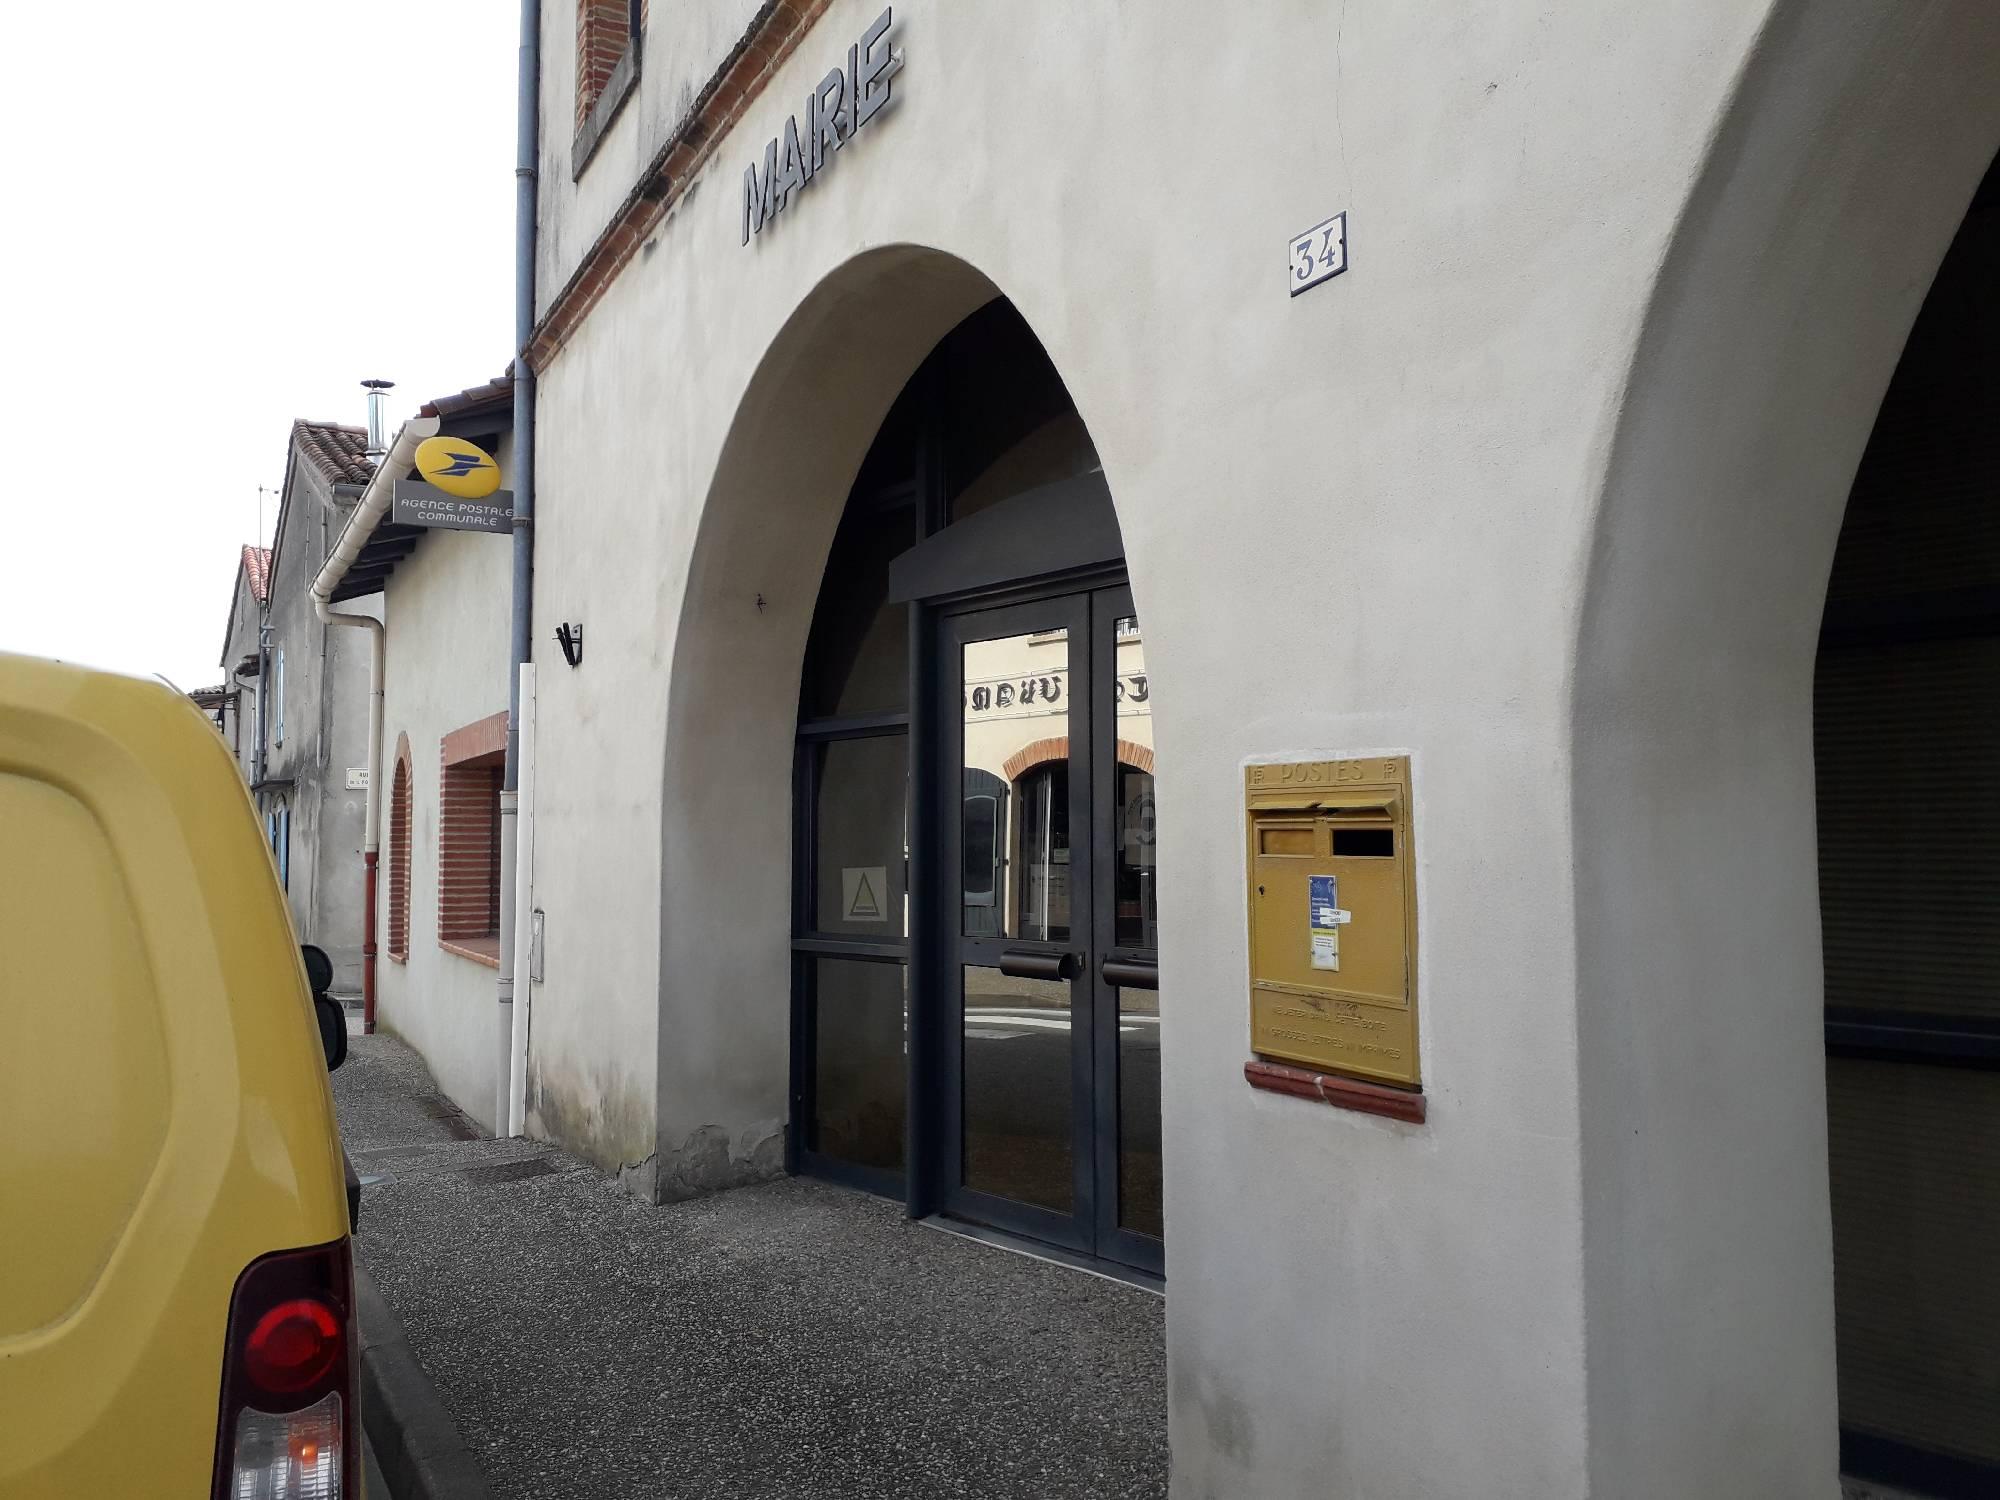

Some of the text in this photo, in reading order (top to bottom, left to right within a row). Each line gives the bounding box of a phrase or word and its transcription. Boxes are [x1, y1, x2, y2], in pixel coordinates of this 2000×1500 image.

[742, 6, 892, 247] MAIRIE
[1296, 227, 1336, 280] 34
[401, 498, 513, 517] AGENCE POSTALE
[417, 511, 498, 526] COMMUNALE
[1280, 758, 1364, 784] POSTES
